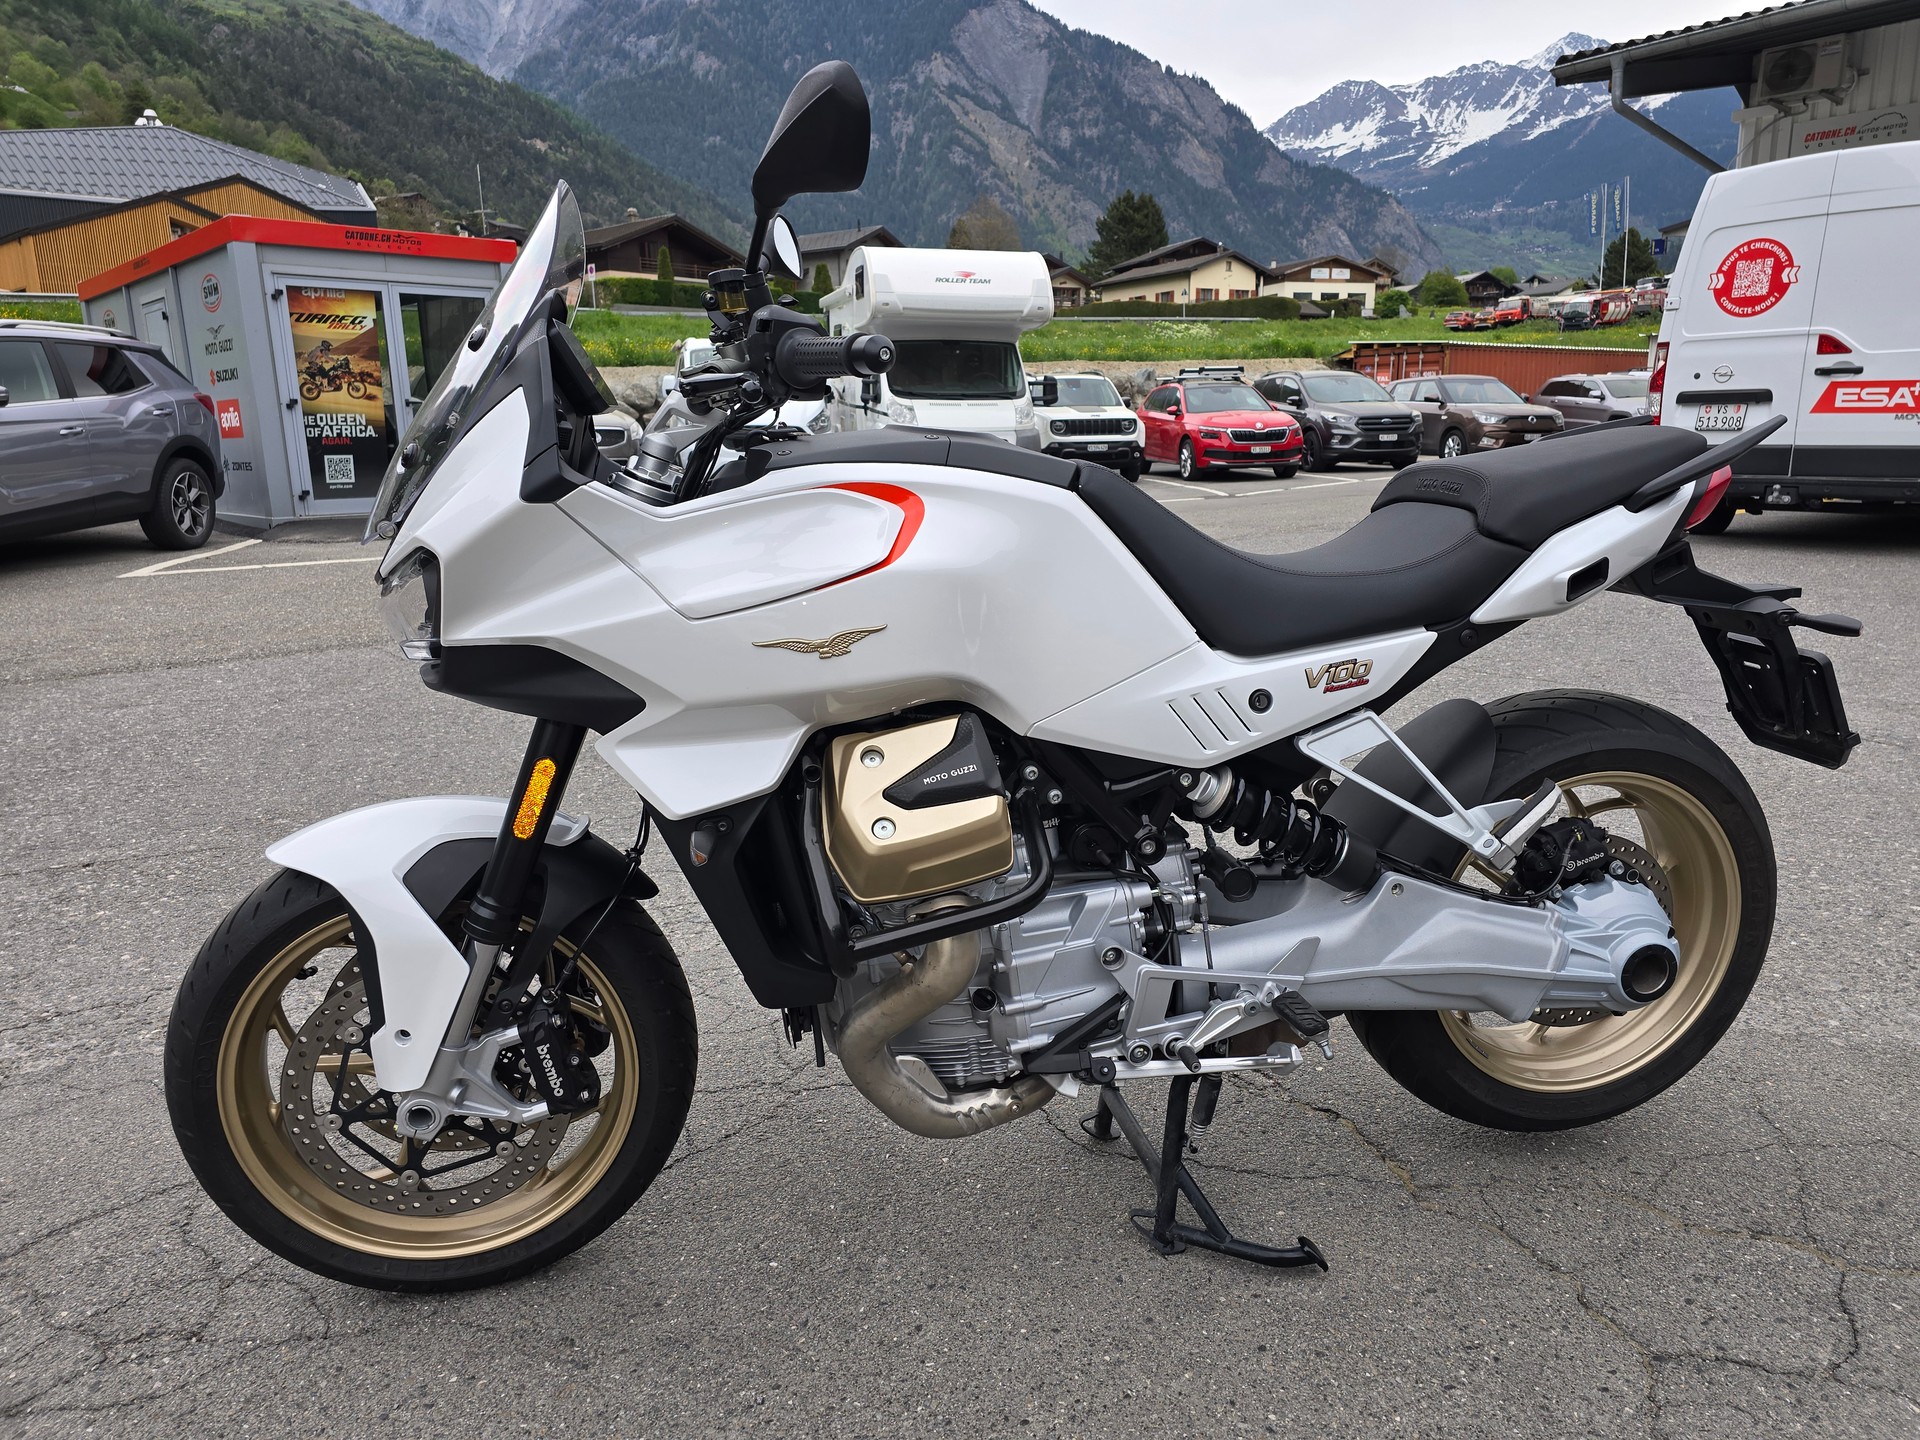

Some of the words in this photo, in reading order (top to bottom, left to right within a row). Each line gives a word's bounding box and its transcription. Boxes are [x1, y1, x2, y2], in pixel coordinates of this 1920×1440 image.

[1804, 126, 1857, 143] CATOGNE.CH
[345, 231, 391, 243] CATOGNE.CH
[1722, 252, 1739, 271] NOUS
[1739, 245, 1749, 254] TE
[203, 282, 220, 300] SWM
[327, 322, 367, 331] RALLY
[205, 341, 218, 356] MOTO
[218, 338, 234, 353] GUZZI
[215, 368, 239, 383] SUZUKI
[1717, 405, 1729, 414] VS
[220, 407, 241, 431] aprilia
[316, 413, 367, 427] QUEEN
[306, 427, 322, 438] OF
[322, 425, 379, 438] AFRICA.
[322, 437, 353, 446] AGAIN.
[232, 462, 253, 471] ZONTES
[1416, 478, 1438, 491] MOTO
[1439, 480, 1464, 496] GUZZI
[1305, 659, 1373, 689] V100
[923, 772, 948, 785] MOTO
[950, 764, 978, 777] GUZZI
[1576, 852, 1605, 867] brembo
[536, 1043, 564, 1097] brembo
